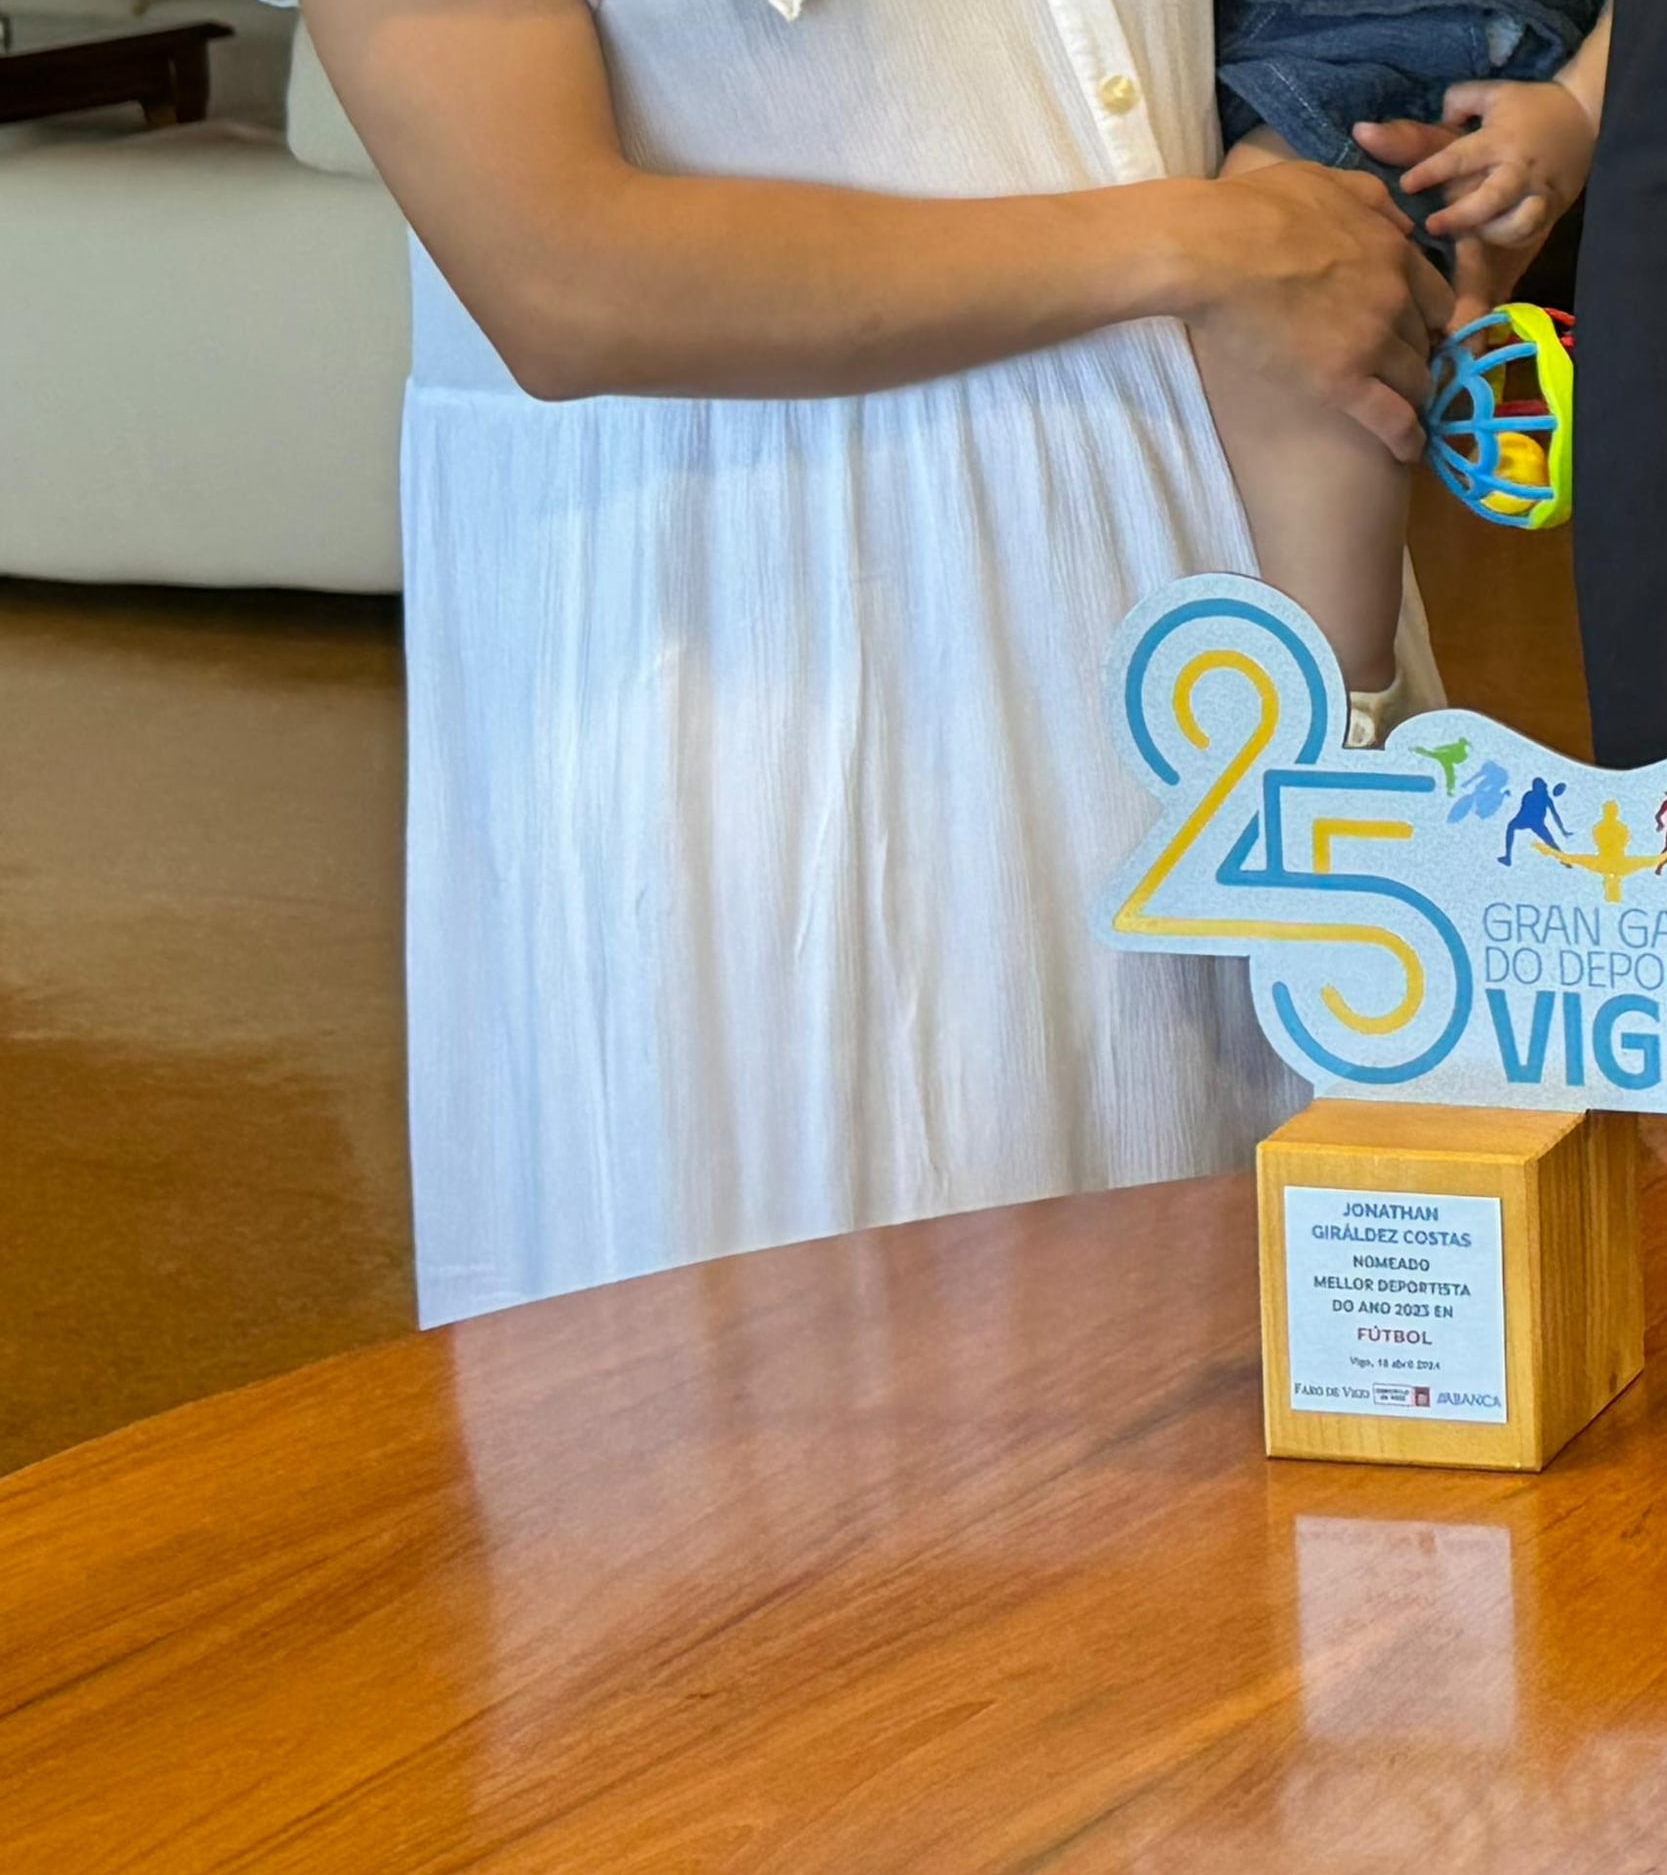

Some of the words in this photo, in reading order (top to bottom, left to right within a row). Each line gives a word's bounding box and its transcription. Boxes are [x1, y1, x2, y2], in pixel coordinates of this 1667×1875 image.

[1481, 901, 1601, 948] GRAN
[1483, 946, 1543, 987] DO
[1342, 1202, 1440, 1223] JONATHAN
[1311, 1222, 1400, 1245] GIRÁLDEZ
[1402, 1229, 1473, 1248] COSTAS
[1352, 1254, 1431, 1273] NOMEADO
[1313, 1275, 1375, 1292] MELLOR
[1377, 1278, 1472, 1298] DEPORTISTA
[1332, 1298, 1355, 1314] DO
[1394, 1302, 1431, 1318] 2023
[1434, 1304, 1454, 1319] EN
[1356, 1324, 1433, 1346] FÚTBOL
